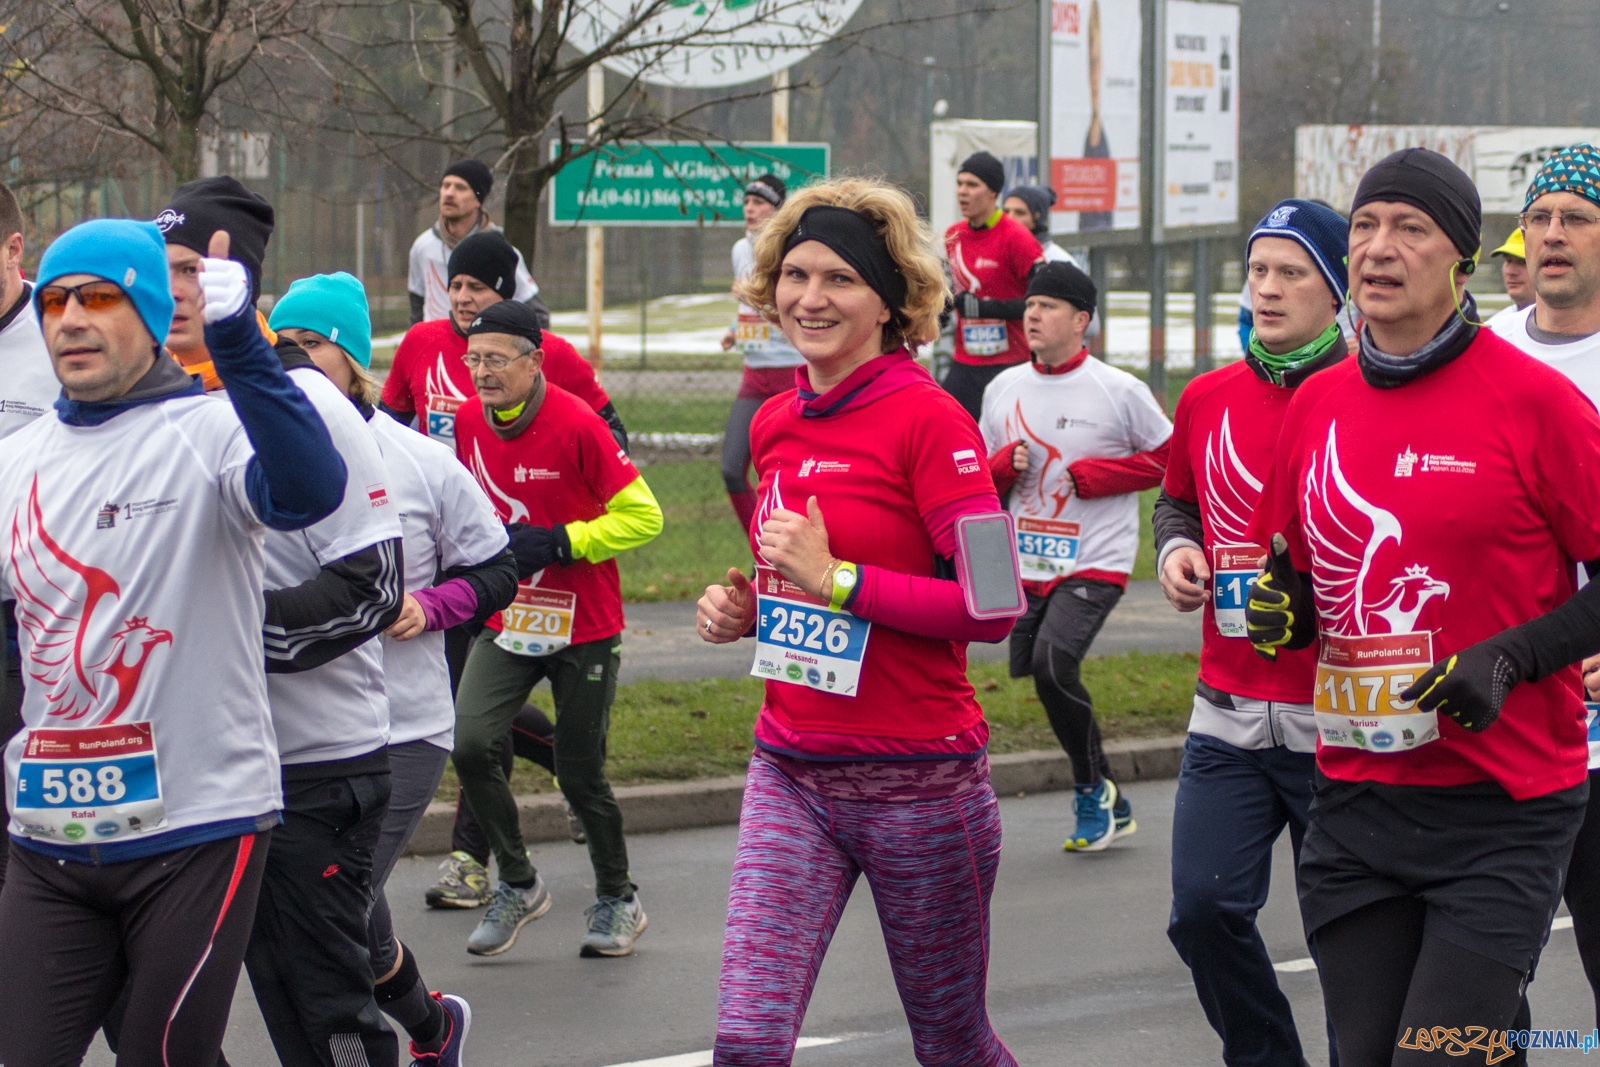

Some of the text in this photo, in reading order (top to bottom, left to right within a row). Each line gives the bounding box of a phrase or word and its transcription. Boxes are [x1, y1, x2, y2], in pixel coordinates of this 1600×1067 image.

[595, 159, 654, 178] Poznań
[164, 213, 185, 225] Rock
[439, 417, 454, 436] 2
[958, 465, 981, 475] POLSKA
[1420, 454, 1429, 472] 1
[371, 498, 389, 508] POLSKA
[124, 503, 132, 520] 1
[1023, 536, 1071, 557] 5126
[1217, 586, 1224, 596] E
[504, 608, 561, 634] 9720
[761, 607, 852, 654] E 2526
[784, 651, 818, 665] Aleksandra
[1357, 648, 1420, 659] RunPoland.org
[760, 659, 774, 668] GRUPA
[758, 666, 776, 676] LUXMED
[1316, 674, 1417, 712] D 1175
[1349, 719, 1379, 727] Mariusz
[79, 736, 143, 750] RunPoland.org
[1325, 734, 1344, 742] LUXMED
[19, 766, 126, 804] E 588
[71, 811, 96, 819] Rafał
